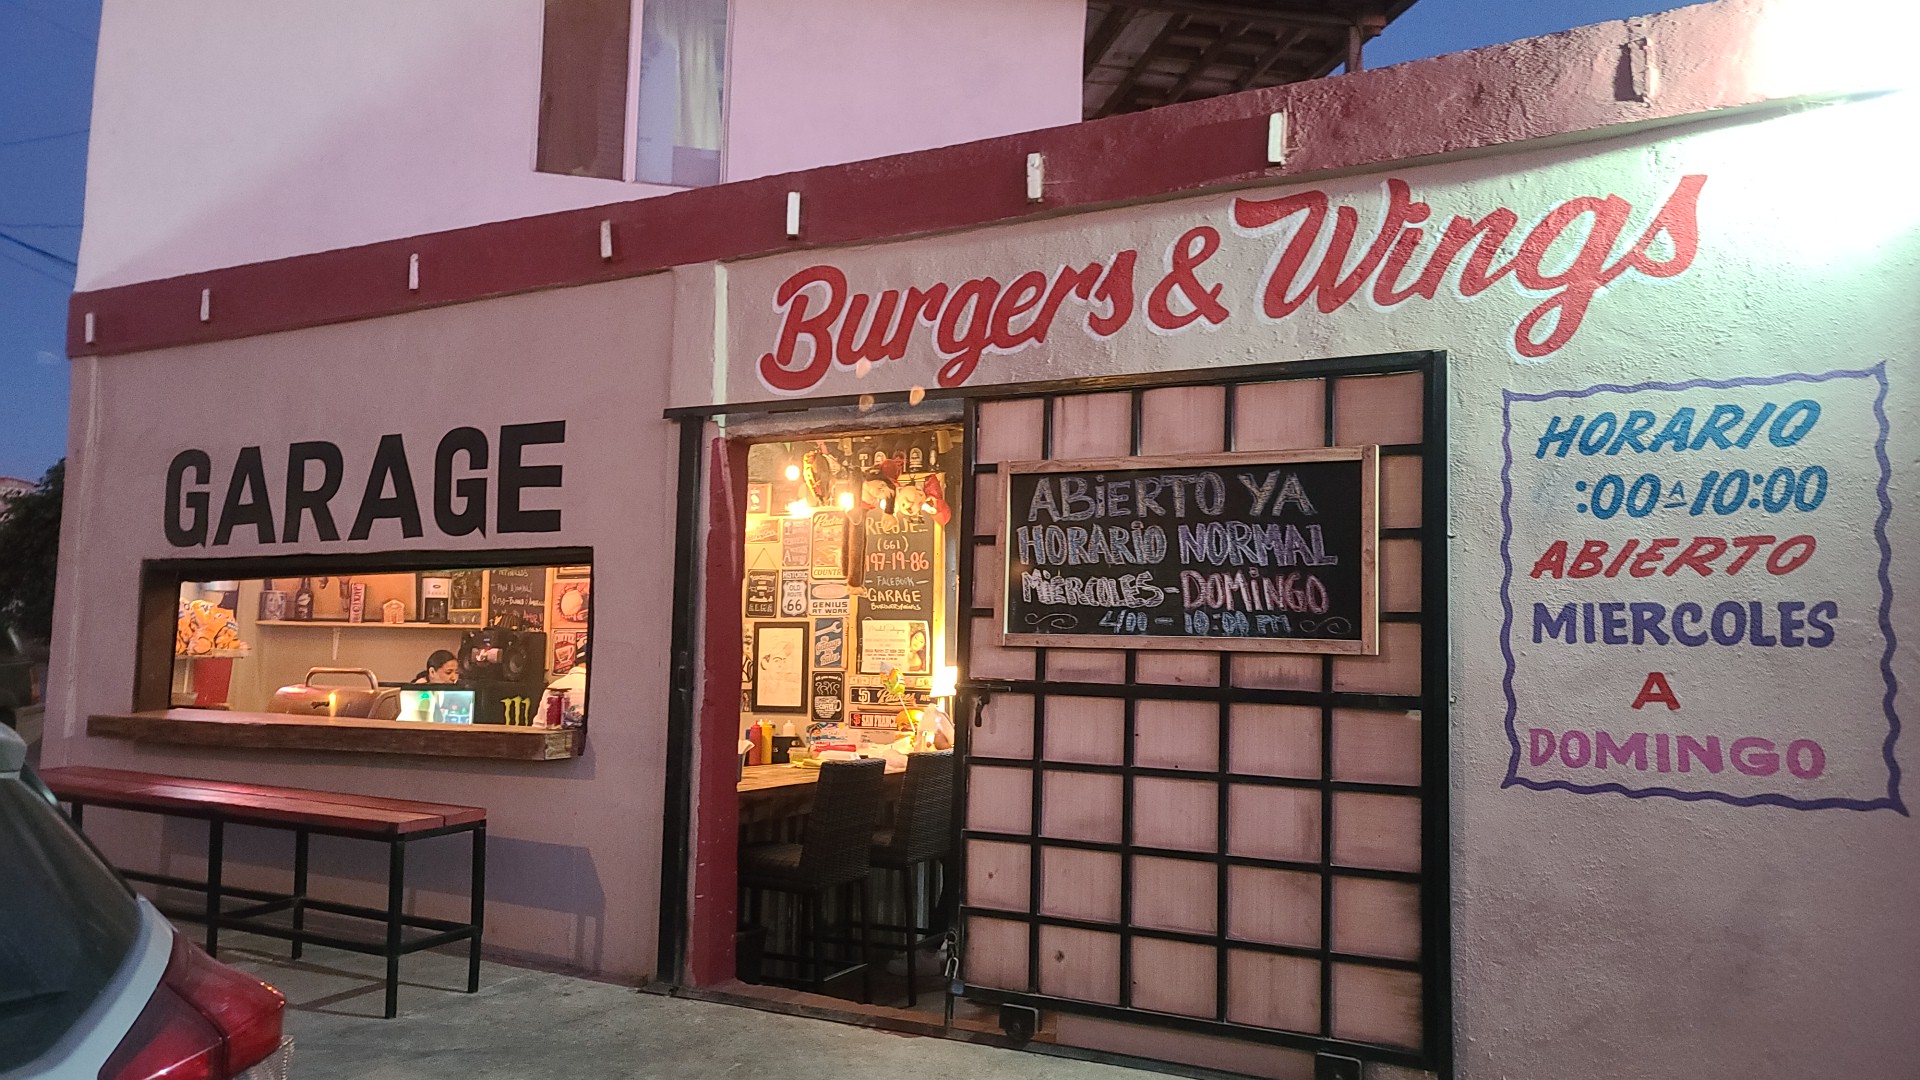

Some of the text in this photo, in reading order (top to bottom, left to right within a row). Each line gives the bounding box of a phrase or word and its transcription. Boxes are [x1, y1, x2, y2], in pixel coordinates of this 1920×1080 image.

[757, 174, 1709, 392] Burgers & Wings
[1535, 399, 1822, 459] HORARIO
[164, 420, 566, 548] GARAGE
[1237, 469, 1318, 517] YA
[1177, 521, 1338, 567] NORMAL
[1529, 534, 1818, 580] ABIERTO
[787, 599, 802, 611] 66
[867, 588, 921, 602] GARAGE
[1254, 613, 1292, 634] PM
[1531, 600, 1839, 648] MIERCOLES
[1630, 671, 1681, 711] A
[861, 714, 873, 727] SAN
[1528, 728, 1826, 780] DOMINGO
